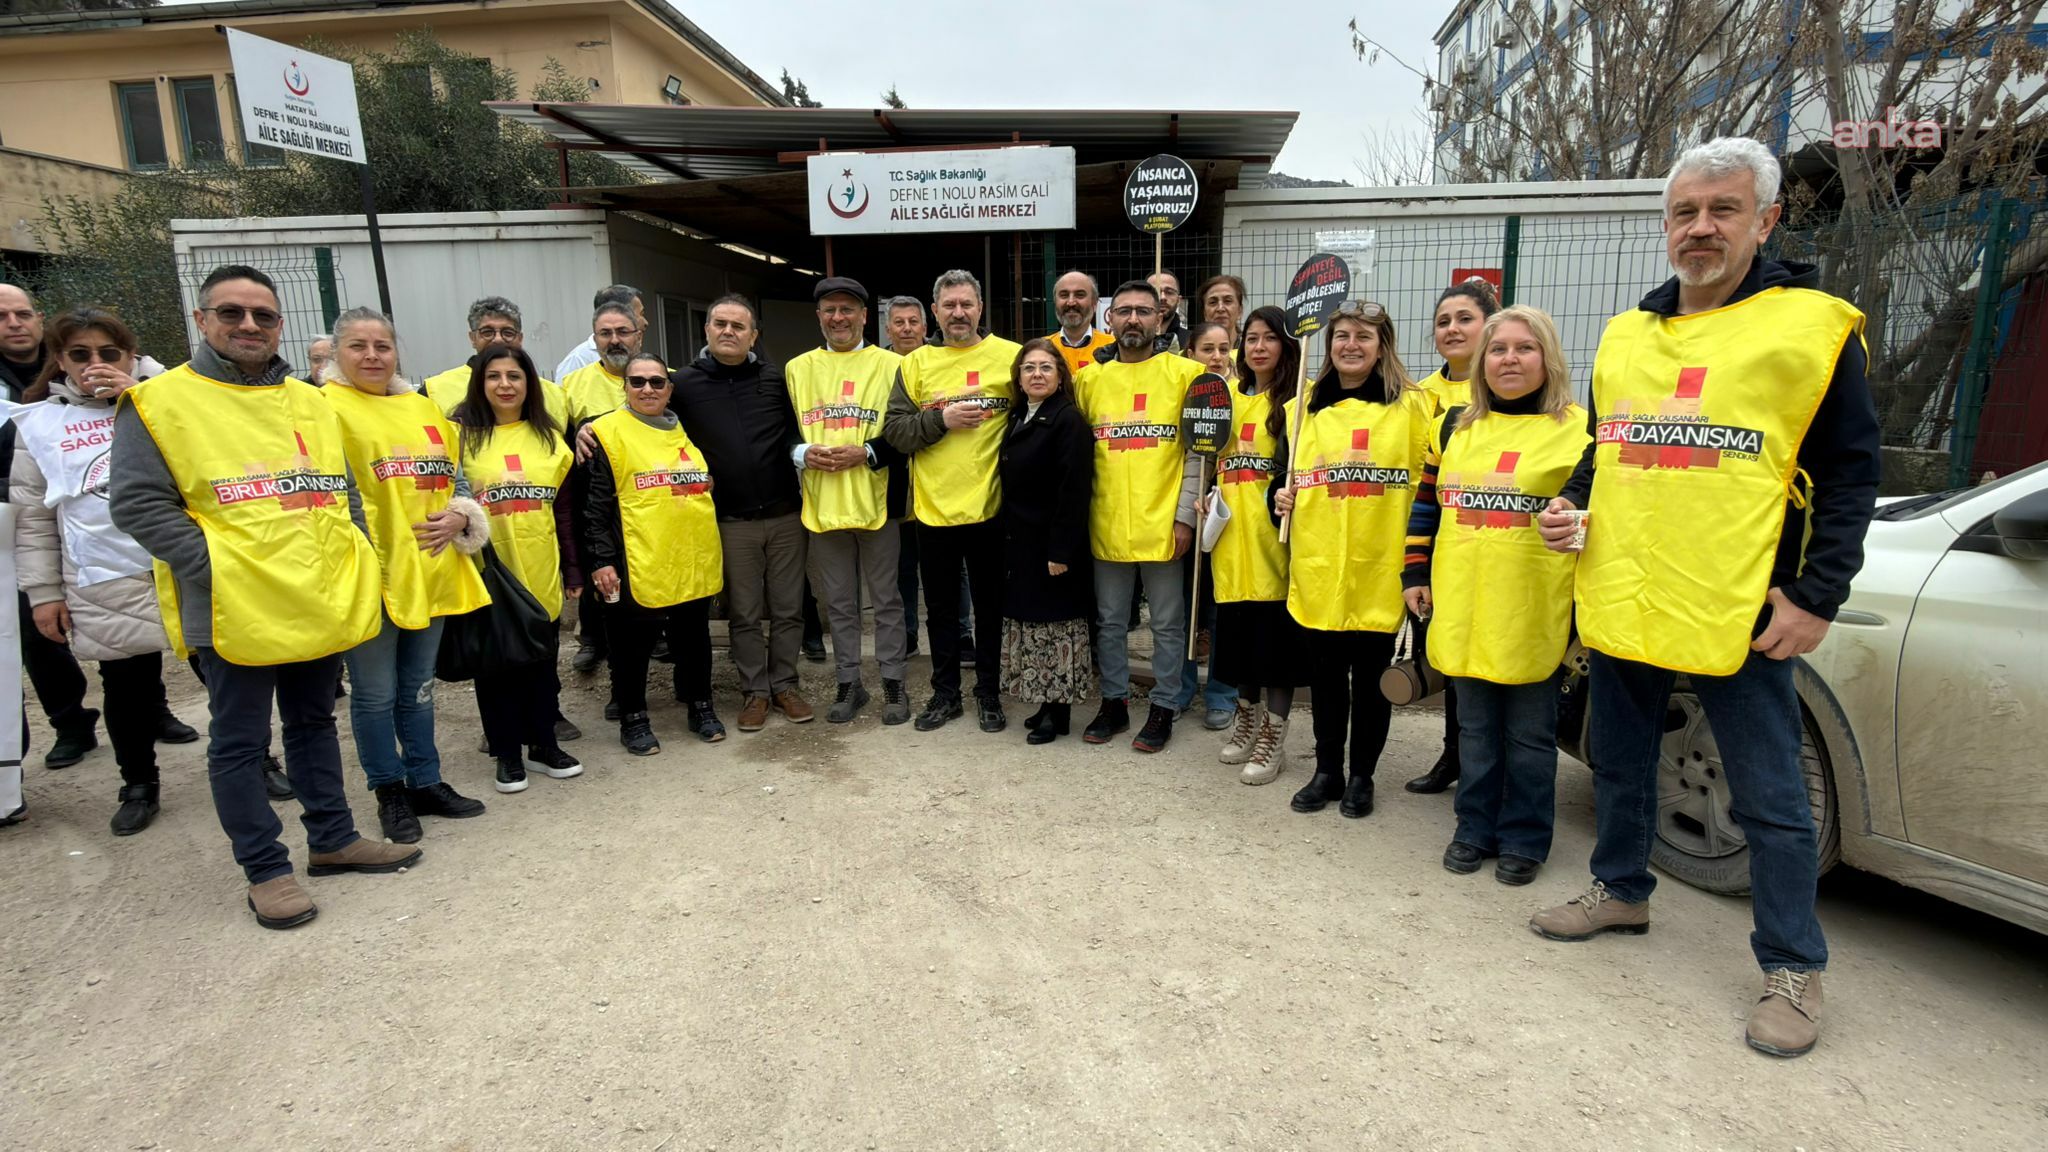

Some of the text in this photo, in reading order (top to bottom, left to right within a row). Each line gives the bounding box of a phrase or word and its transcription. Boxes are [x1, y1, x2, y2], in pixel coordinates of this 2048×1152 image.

[284, 103, 307, 115] HATAY
[253, 106, 350, 138] DEFNE 1 NOLU RASİM GALİ
[258, 122, 353, 158] AİLE SAĞLIĞI MERKEZİ
[906, 169, 938, 183] Sağlık
[939, 168, 987, 182] Bakanlığı
[1137, 167, 1187, 182] İNSANCA
[889, 181, 1049, 202] DEFNE 1 NOLU RASİM GALİ
[1130, 184, 1193, 200] YAŞAMAK
[890, 201, 1037, 221] AİLE SAĞLIĞI MERKEZİ
[1130, 201, 1190, 216] İSTİYORUZ!
[1286, 281, 1347, 310] DEPREM BÖLGESİNE
[1297, 300, 1323, 318] BÜTÇE!
[1183, 406, 1231, 420] DEPREM BÖLGESİNE
[1193, 421, 1217, 436] BÜTÇE!
